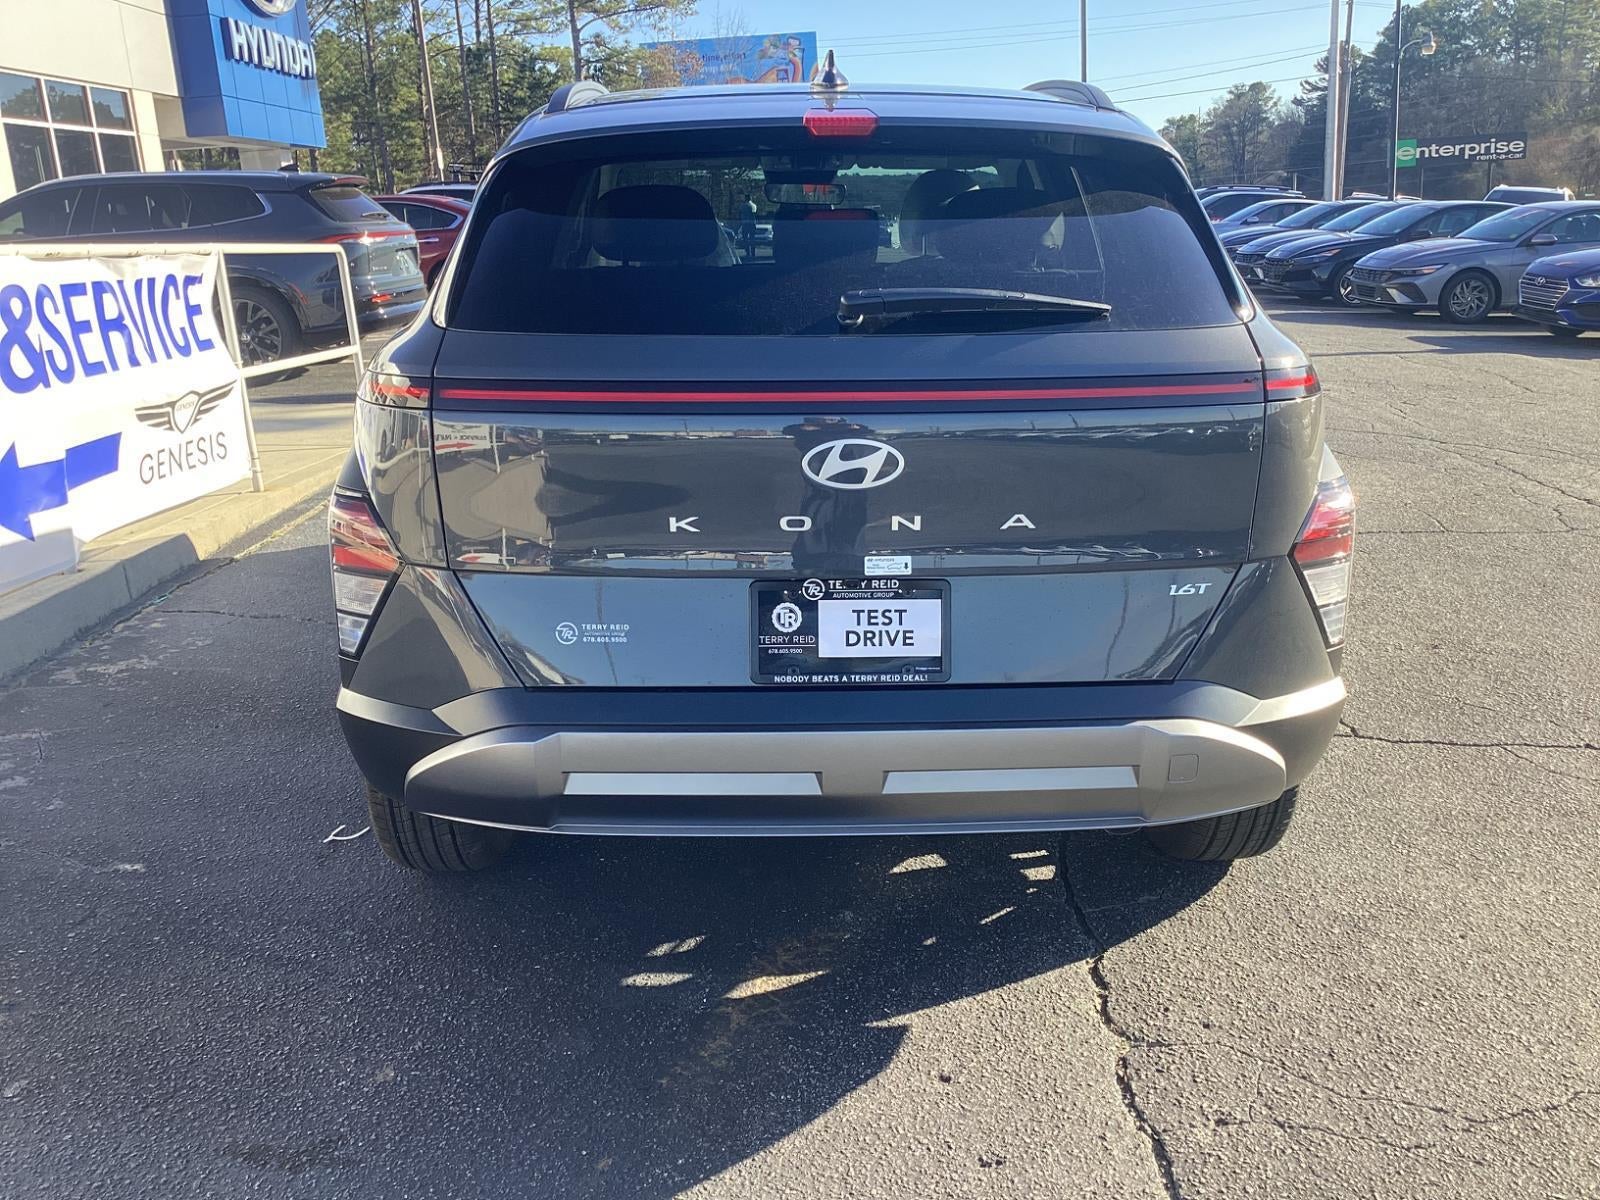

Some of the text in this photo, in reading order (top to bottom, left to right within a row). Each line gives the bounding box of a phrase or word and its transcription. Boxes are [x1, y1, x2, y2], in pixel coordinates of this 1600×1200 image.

[228, 17, 317, 78] HYUNDAI
[1397, 138, 1525, 160] enterprise
[1476, 152, 1524, 161] rent-a-car
[139, 432, 228, 485] GENESIS
[669, 514, 1036, 532] KONA
[828, 579, 899, 589] TEY REID
[852, 609, 907, 626] TEST
[759, 635, 816, 644] TERRY REID
[845, 630, 915, 647] DRIVE
[774, 675, 809, 683] NOBODY
